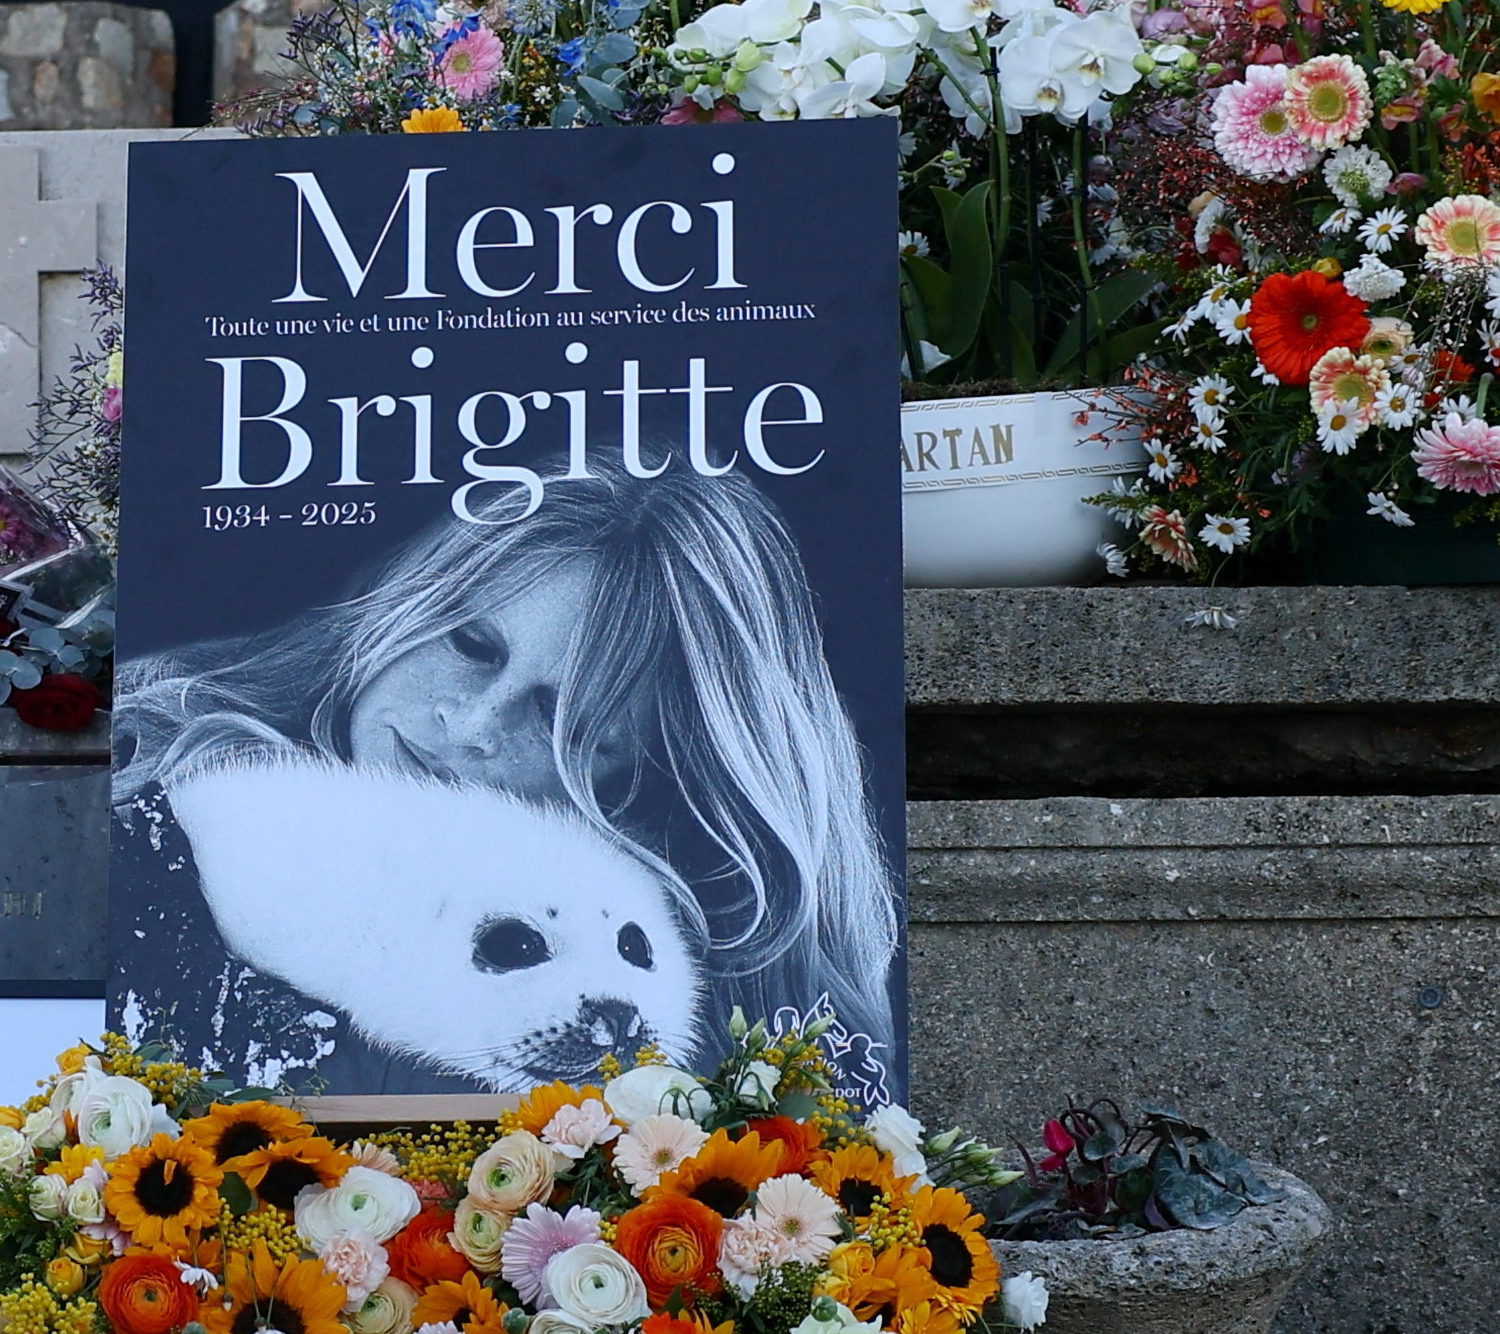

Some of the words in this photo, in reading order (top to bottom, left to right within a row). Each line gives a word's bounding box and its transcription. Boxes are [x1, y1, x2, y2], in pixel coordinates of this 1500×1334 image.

[272, 153, 748, 303] Merci
[206, 315, 269, 337] Toute
[276, 319, 317, 335] une
[322, 314, 355, 334] vie
[359, 314, 381, 333] et
[388, 316, 430, 332] une
[437, 309, 551, 331] Fondation
[556, 312, 585, 328] au
[590, 304, 667, 327] service
[672, 302, 711, 323] des
[716, 303, 816, 322] animaux
[201, 342, 825, 525] Brigitte
[202, 504, 270, 531] 1934
[301, 502, 377, 527] 2025
